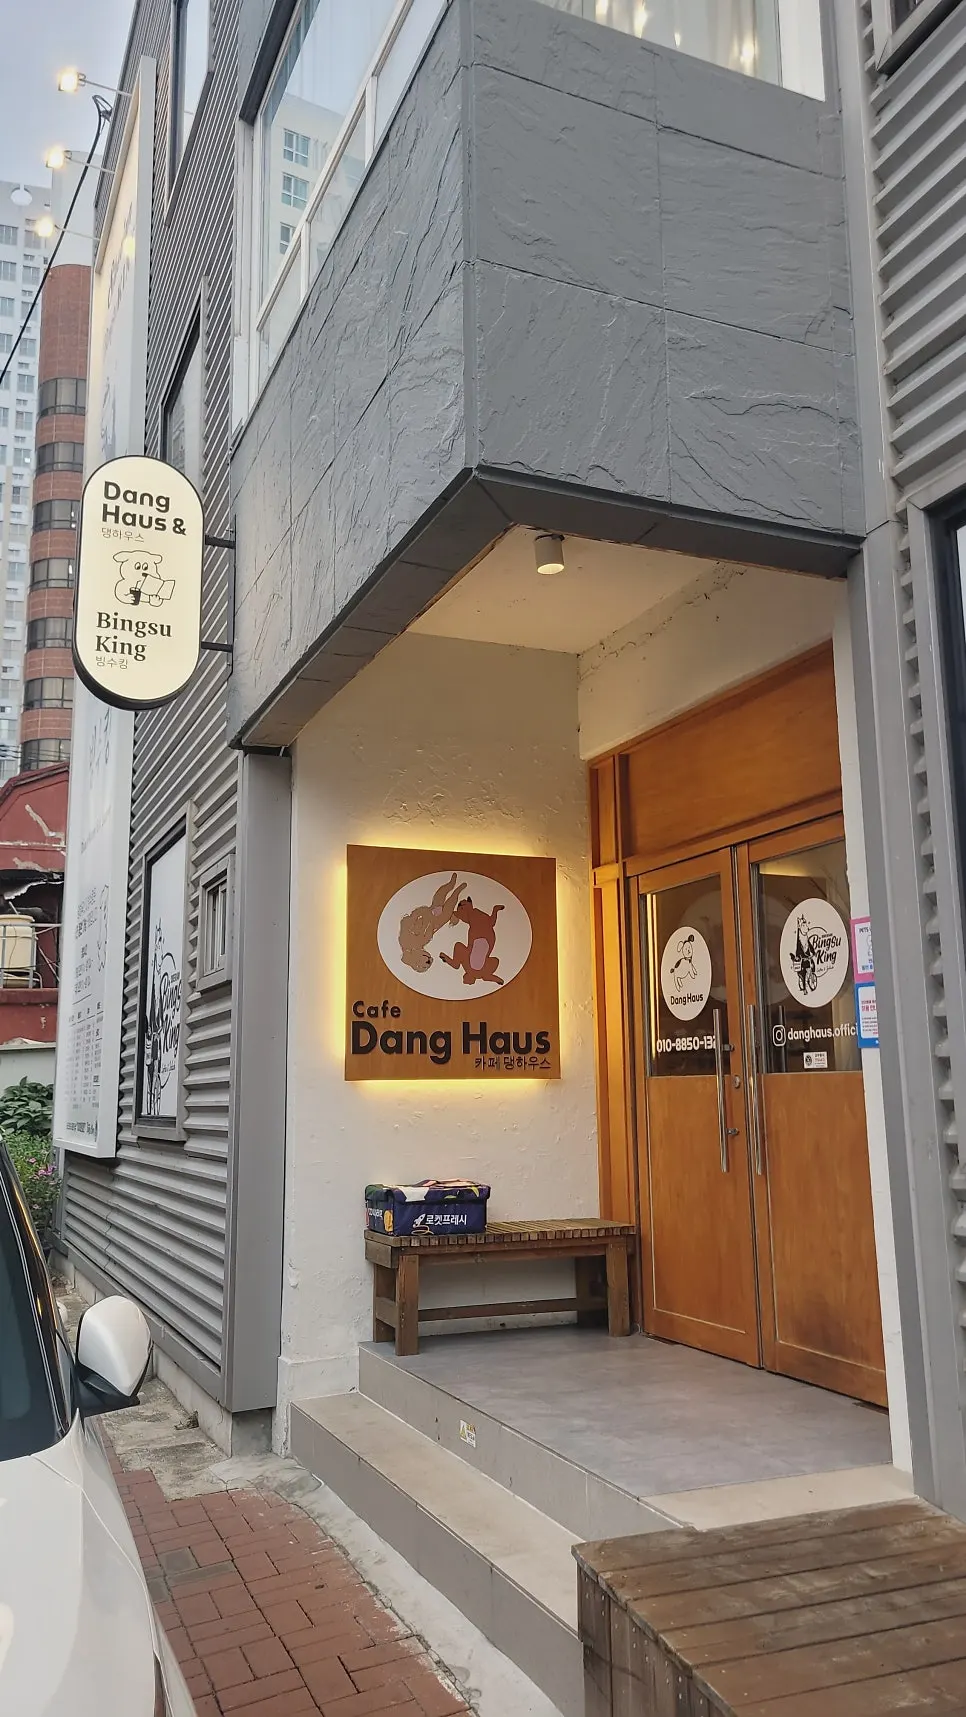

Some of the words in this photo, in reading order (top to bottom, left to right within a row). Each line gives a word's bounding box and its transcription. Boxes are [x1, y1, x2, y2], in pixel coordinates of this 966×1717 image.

[103, 481, 171, 513] Dang
[102, 503, 167, 532] Haus
[172, 517, 187, 536] &
[101, 527, 145, 543] 댕하우스
[97, 611, 172, 638] Bingsu
[95, 635, 147, 662] King
[95, 655, 129, 670] 빙수킹
[815, 949, 837, 965] King
[352, 1000, 402, 1018] Cafe
[351, 1020, 452, 1065] Dang
[462, 1021, 551, 1055] Haus
[503, 1056, 552, 1070] 댕하우스
[425, 1214, 467, 1226] 로켓프레시
